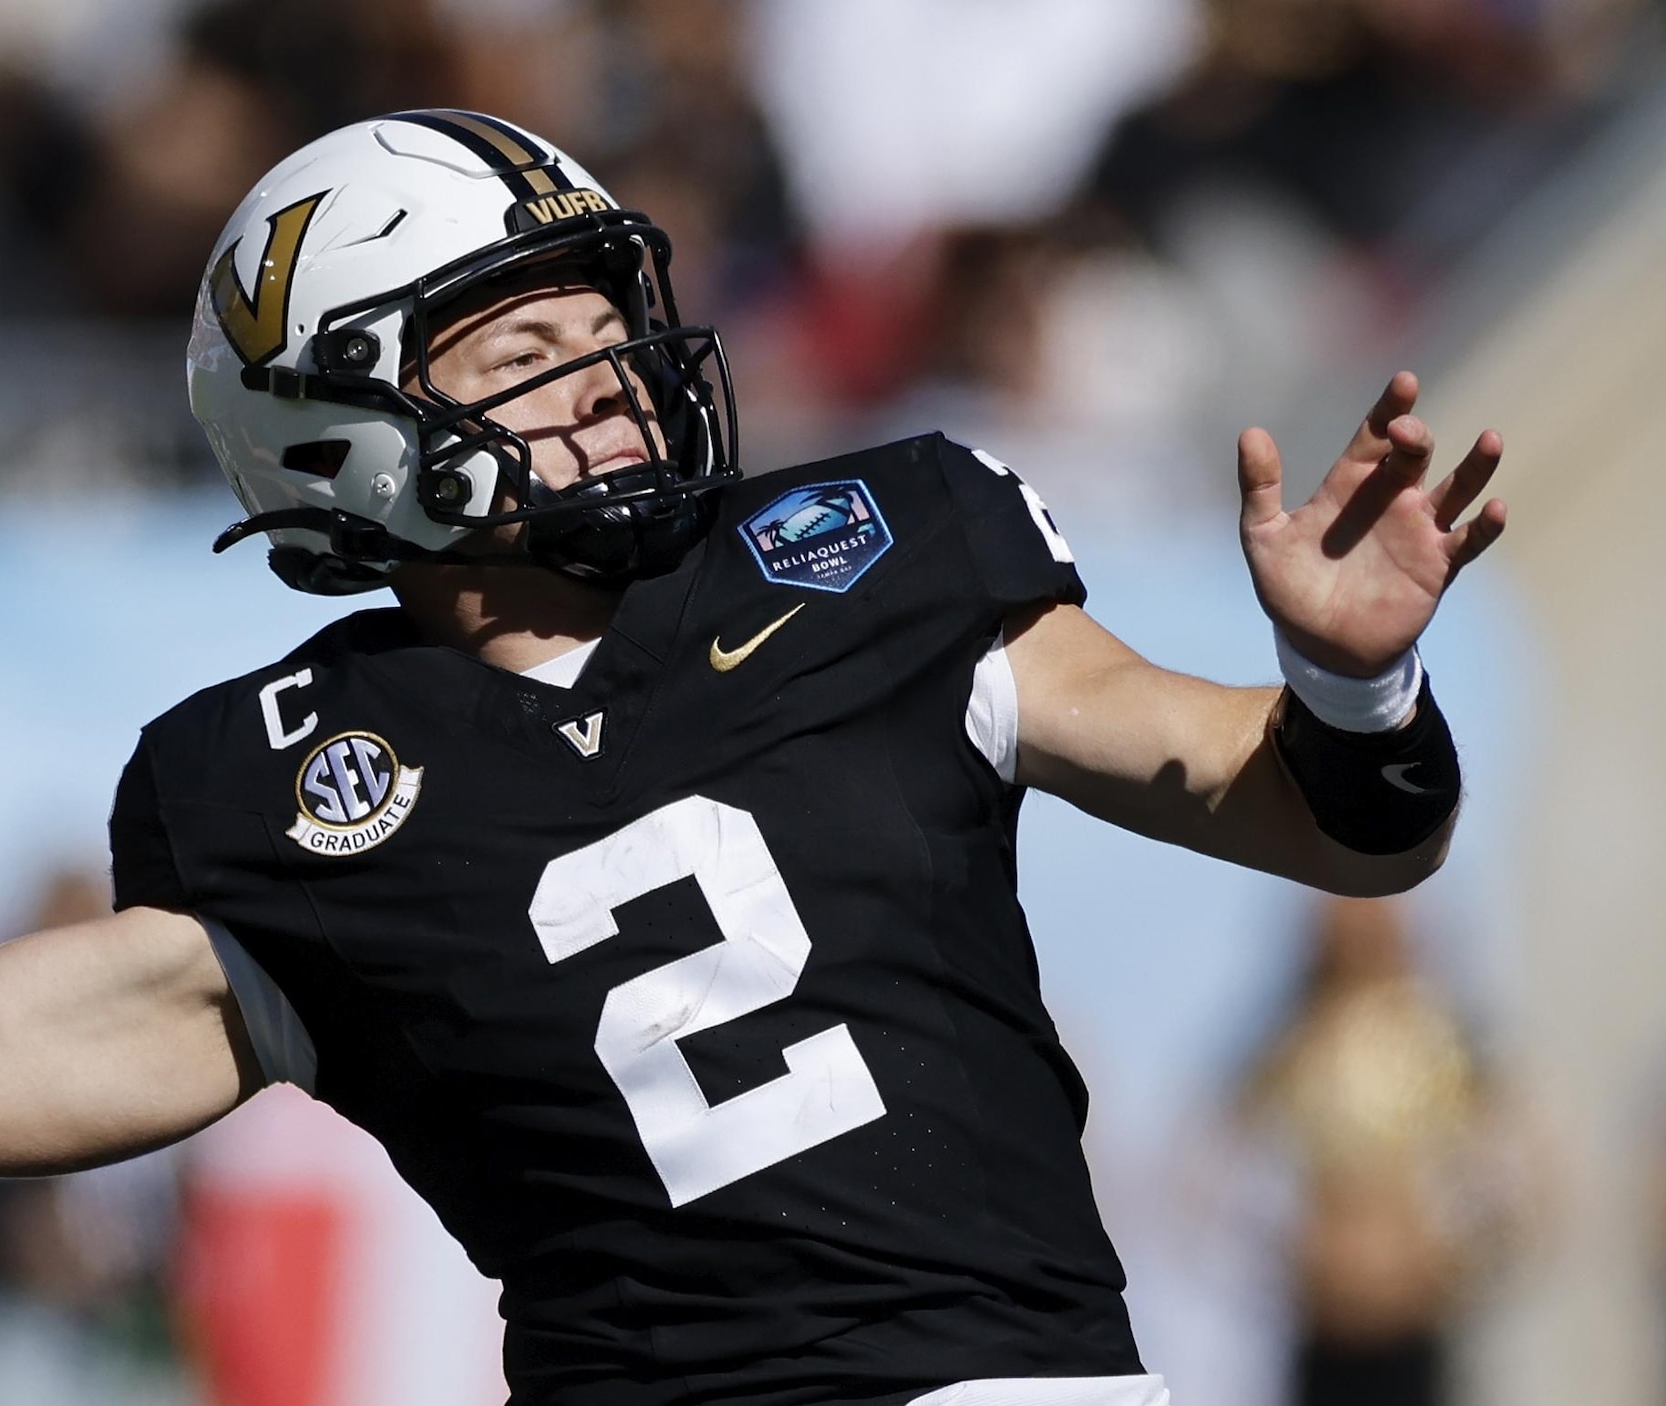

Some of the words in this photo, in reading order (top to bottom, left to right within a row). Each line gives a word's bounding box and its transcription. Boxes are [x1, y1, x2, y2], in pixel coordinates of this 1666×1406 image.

[524, 190, 609, 225] VUFB
[209, 187, 334, 366] V
[772, 534, 867, 572] RELIAQUEST
[811, 556, 848, 573] BOWL
[258, 667, 319, 750] C
[556, 711, 604, 758] V
[304, 737, 391, 823] SEC
[310, 793, 411, 852] GRADUATE
[527, 794, 888, 1209] 2
